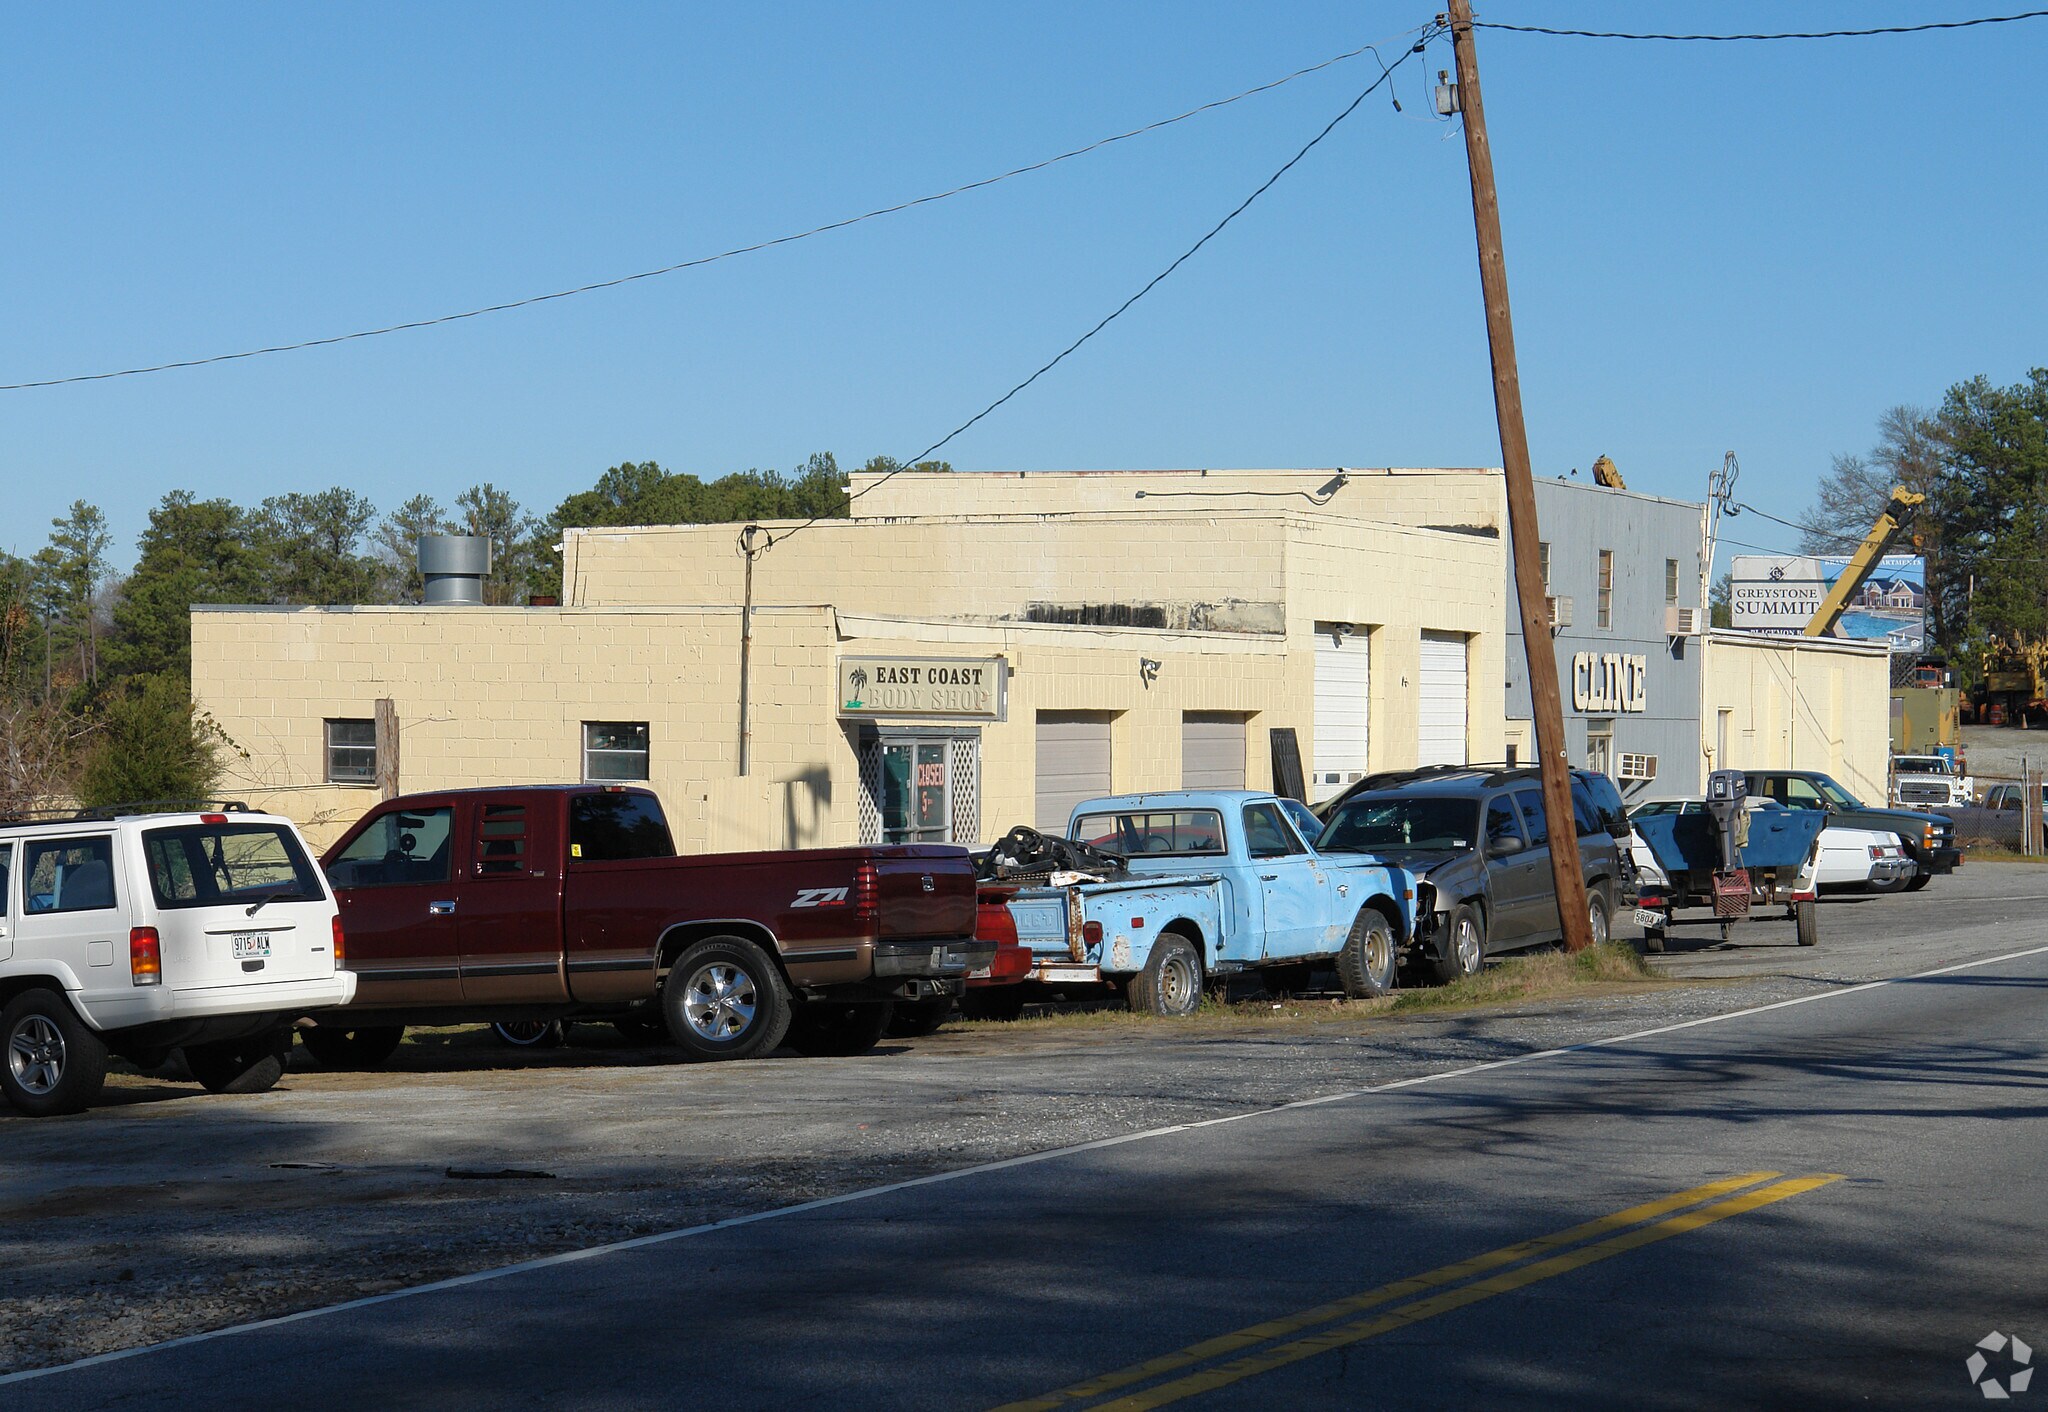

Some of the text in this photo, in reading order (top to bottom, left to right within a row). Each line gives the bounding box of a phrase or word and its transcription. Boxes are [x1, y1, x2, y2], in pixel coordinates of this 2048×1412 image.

[1736, 588, 1818, 599] GREYSTONE
[1735, 600, 1820, 615] SUMMIT
[876, 666, 983, 685] EAST COAST
[1572, 651, 1647, 712] CLINE
[869, 687, 990, 711] BODY SHOP
[917, 763, 945, 786] CLOSED
[790, 887, 849, 908] Z71
[234, 937, 251, 951] 9715
